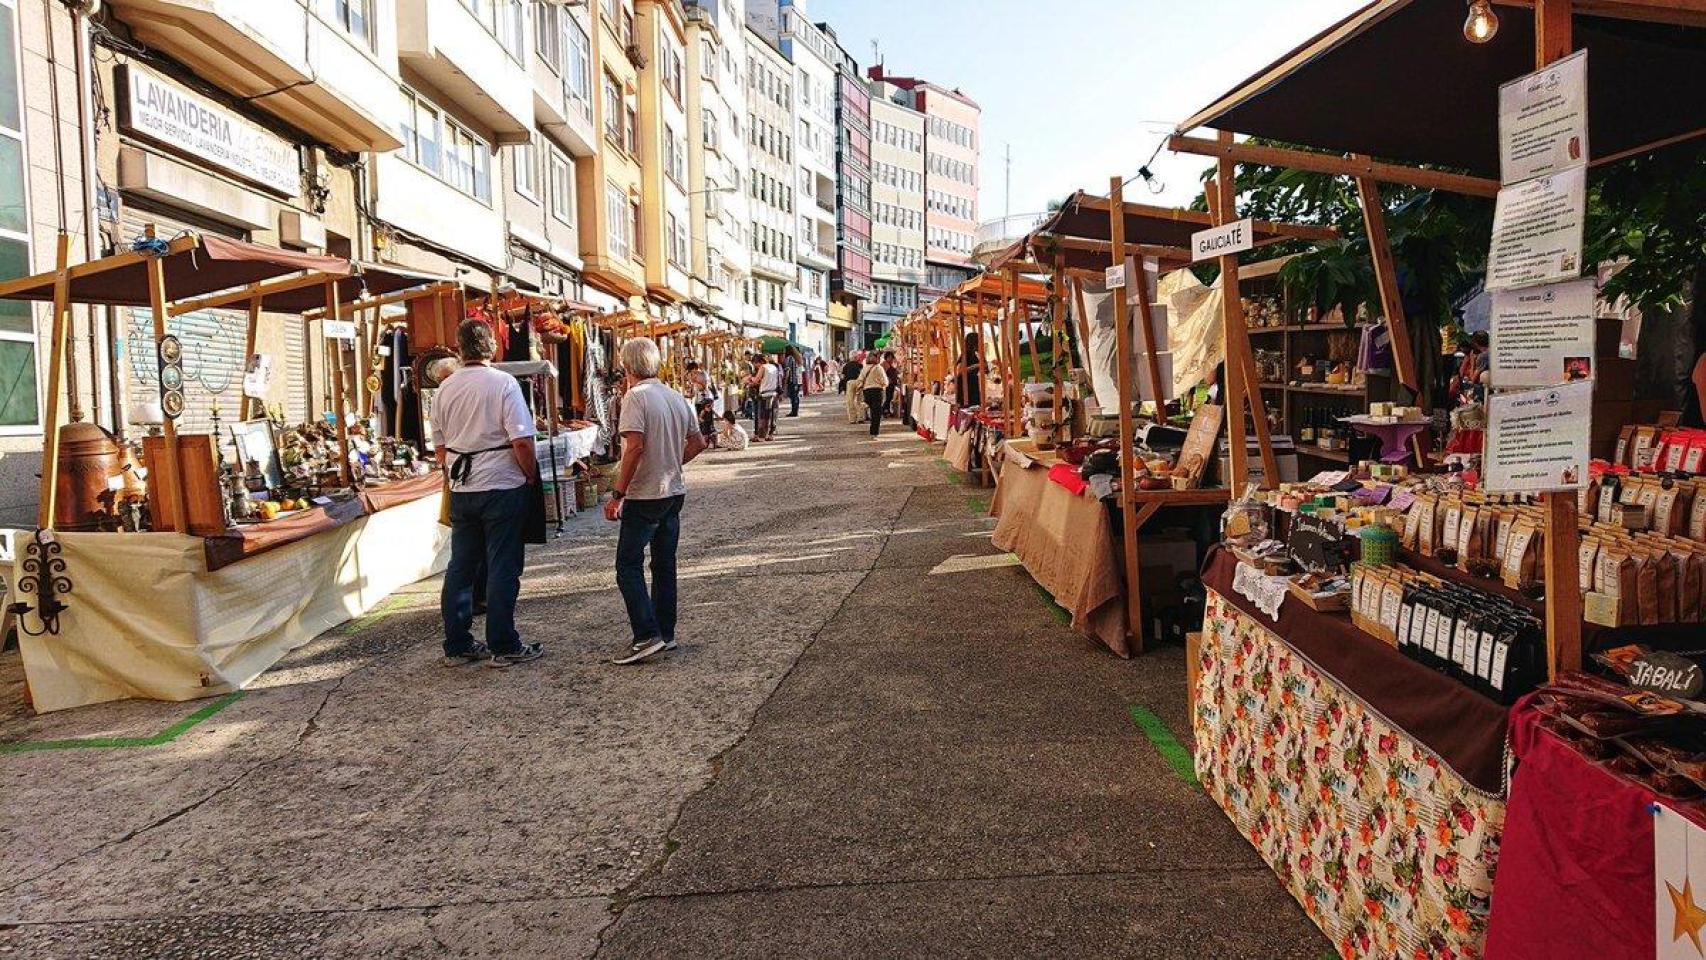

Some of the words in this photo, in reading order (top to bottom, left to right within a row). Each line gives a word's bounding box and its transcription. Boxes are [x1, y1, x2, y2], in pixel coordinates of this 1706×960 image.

[134, 74, 233, 147] LAVANDERIA
[138, 110, 163, 131] MEJOR
[164, 119, 193, 146] SERVICIO
[1629, 659, 1698, 692] JABALÍ
